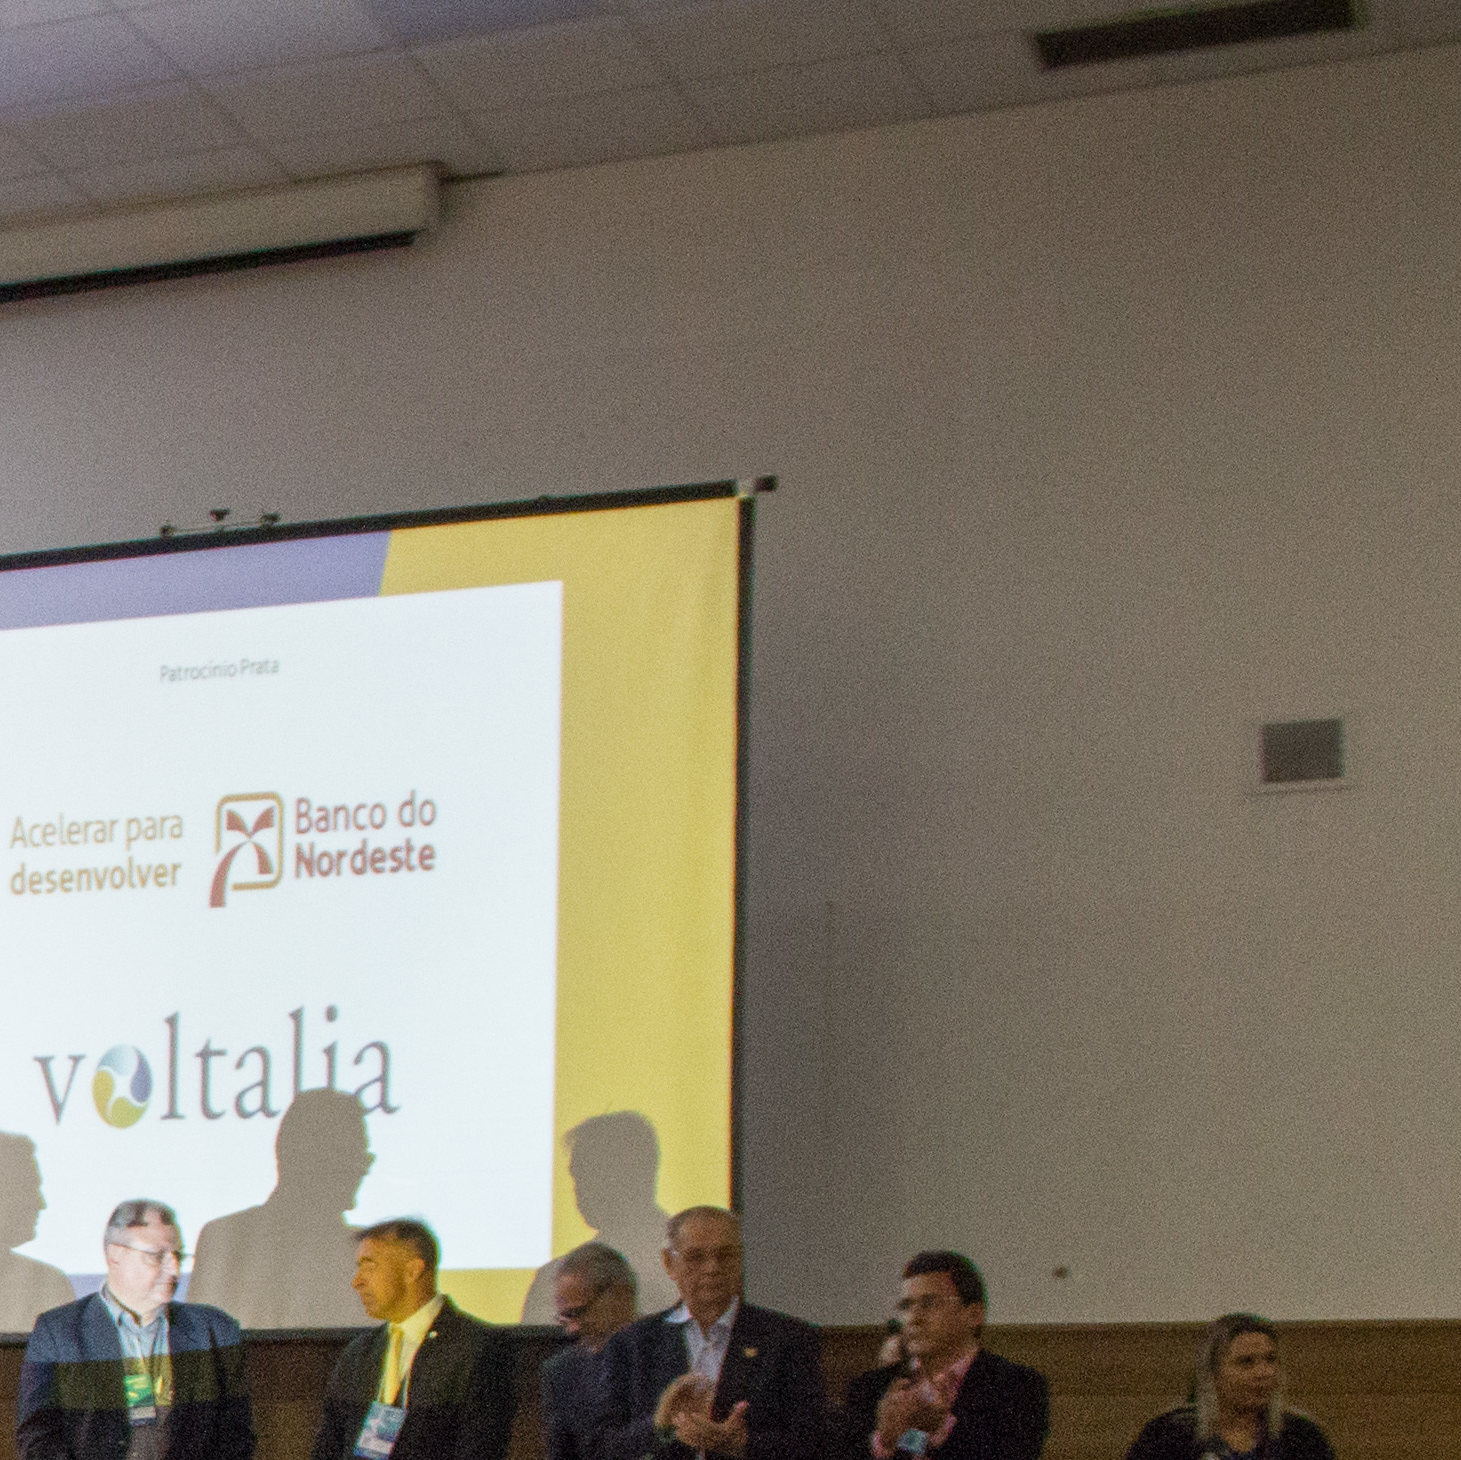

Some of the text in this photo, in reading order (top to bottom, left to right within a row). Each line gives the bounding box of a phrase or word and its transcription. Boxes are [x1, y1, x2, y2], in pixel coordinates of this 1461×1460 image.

[159, 658, 280, 683] Patrocínio Prata
[9, 813, 184, 852] Acelerar para
[294, 789, 437, 836] Banco do
[9, 857, 182, 897] desenvolver
[294, 838, 437, 880] Nordeste
[33, 1003, 403, 1129] voltalia
